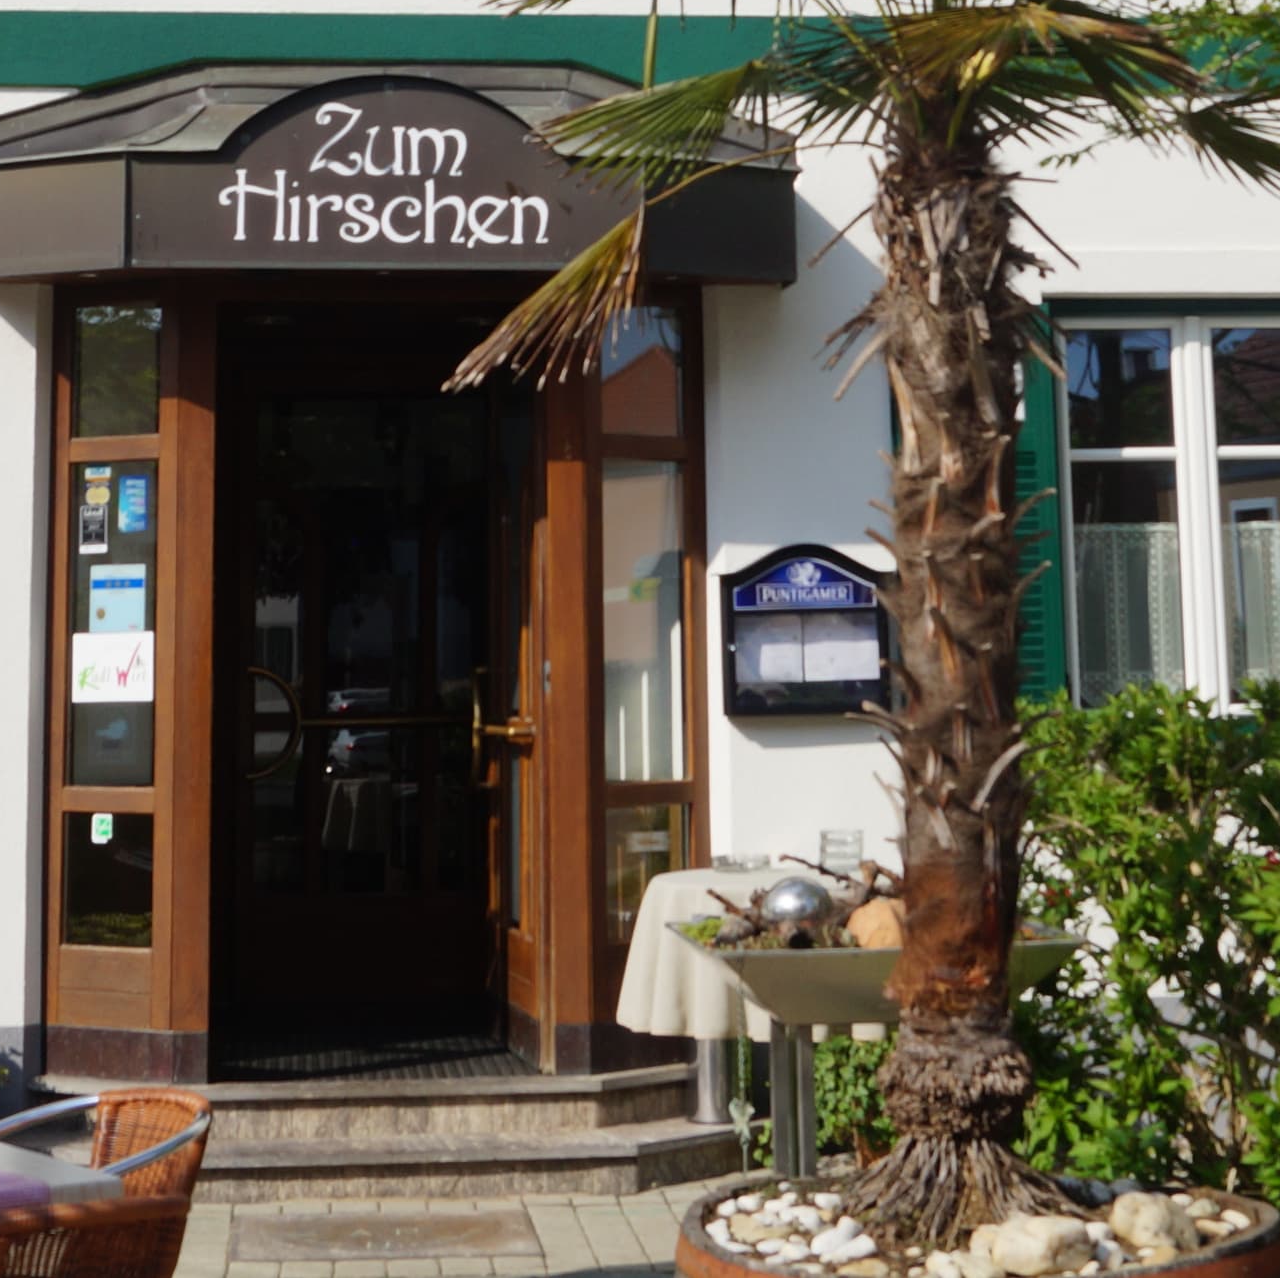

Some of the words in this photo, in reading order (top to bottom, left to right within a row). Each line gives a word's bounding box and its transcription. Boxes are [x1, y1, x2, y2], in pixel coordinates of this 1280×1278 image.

[308, 102, 468, 178] Zum
[218, 168, 550, 249] Hirschen
[762, 586, 848, 602] PUNTIGAMER
